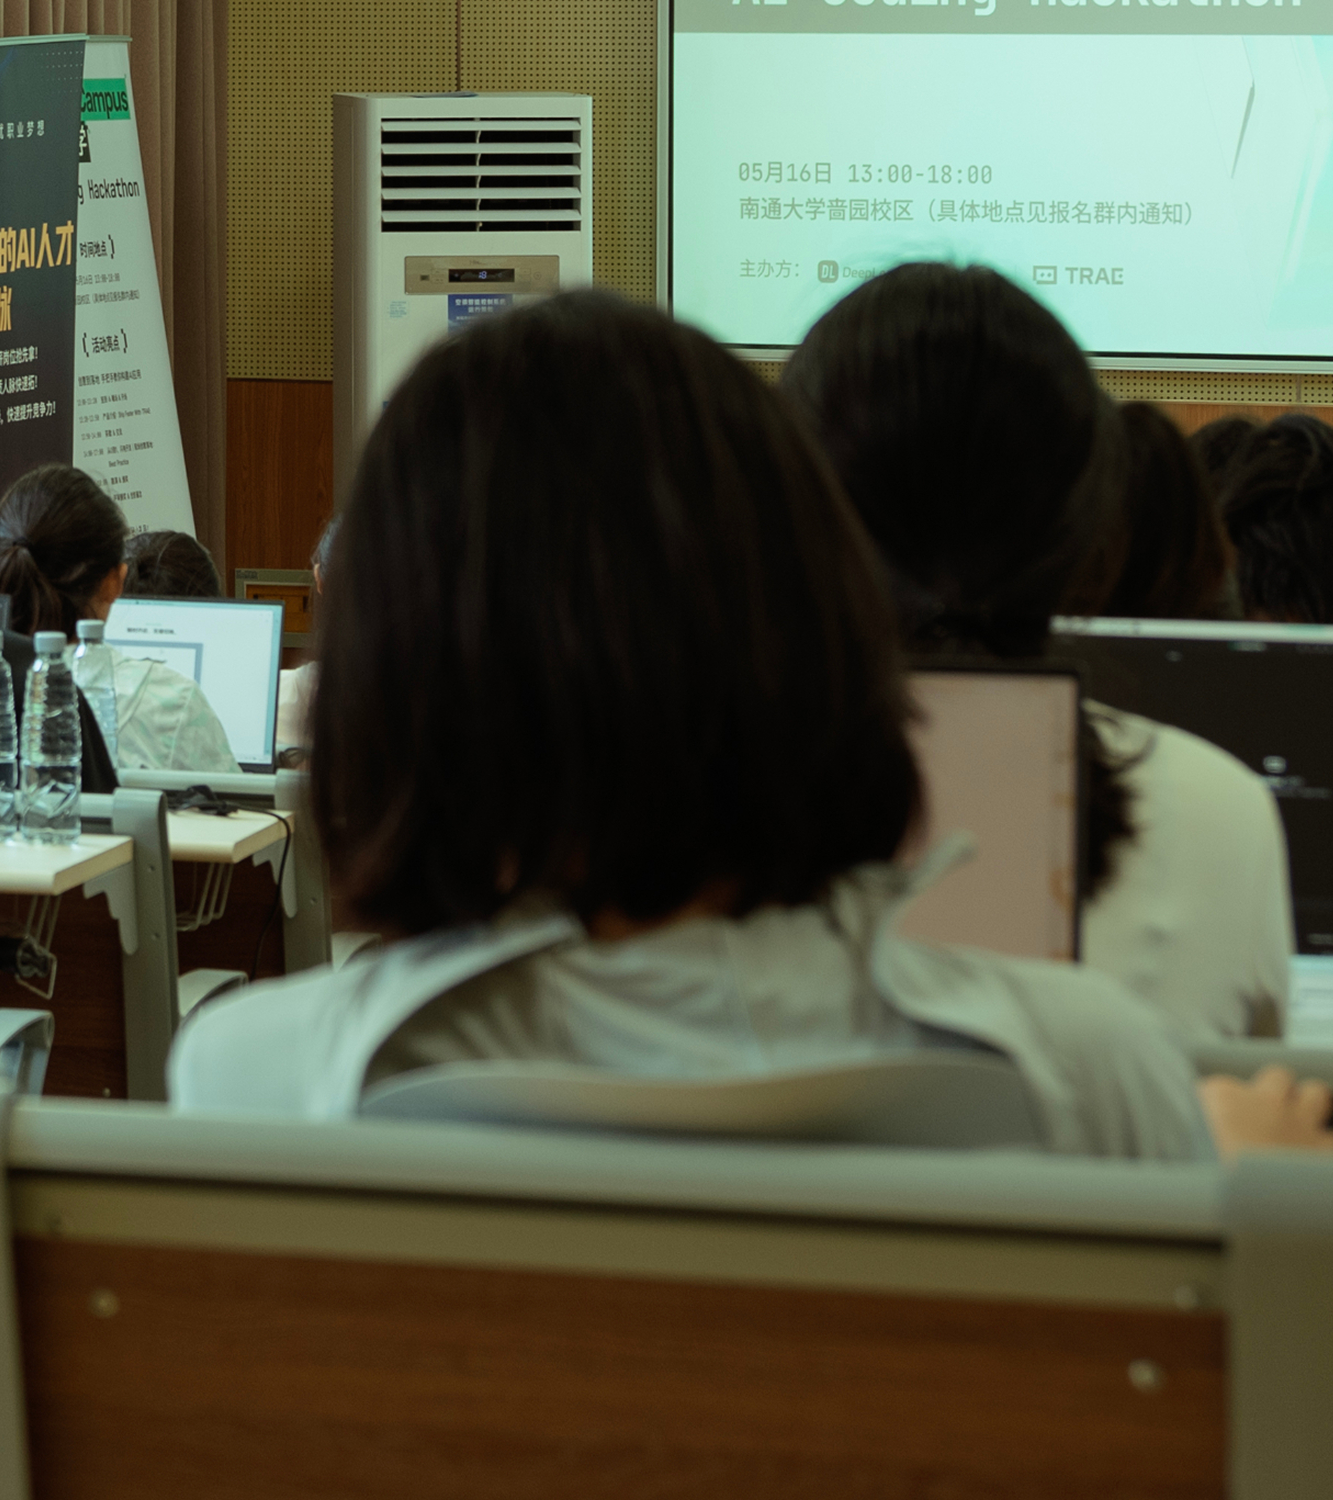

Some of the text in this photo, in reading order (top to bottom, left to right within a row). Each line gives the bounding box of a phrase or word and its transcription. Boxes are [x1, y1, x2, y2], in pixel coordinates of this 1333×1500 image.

[738, 161, 993, 185] 05月16日 13:00-18:00
[87, 178, 140, 199] Hackathon
[739, 258, 799, 279] 主办方：
[1065, 266, 1124, 285] TRAE
